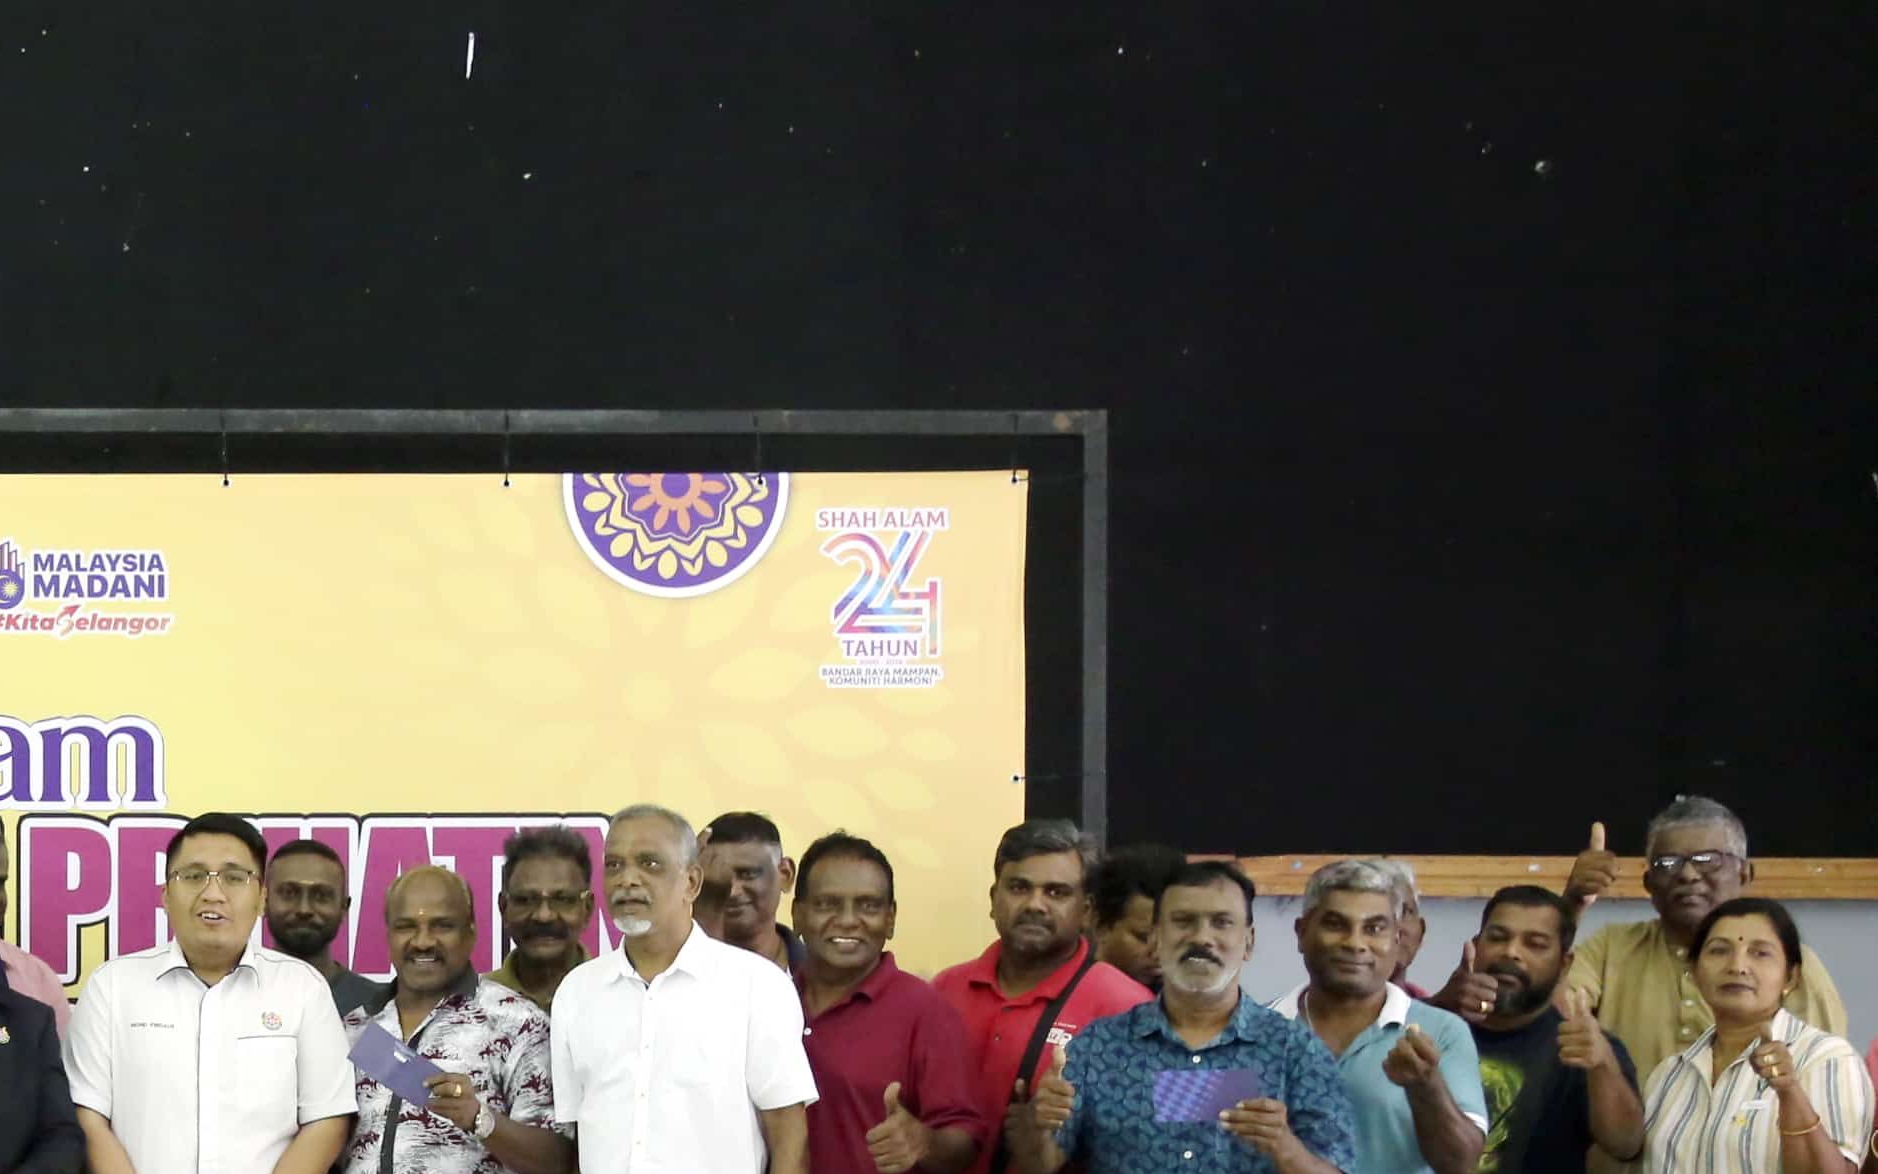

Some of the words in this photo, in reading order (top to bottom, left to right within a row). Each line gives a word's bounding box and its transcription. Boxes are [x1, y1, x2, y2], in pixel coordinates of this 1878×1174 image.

[818, 511, 876, 528] SHAH
[884, 511, 945, 528] ALAM
[33, 553, 164, 572] MALAYSIA
[33, 574, 165, 598] MADANI
[823, 530, 938, 655] 24
[842, 639, 918, 657] TAHUN
